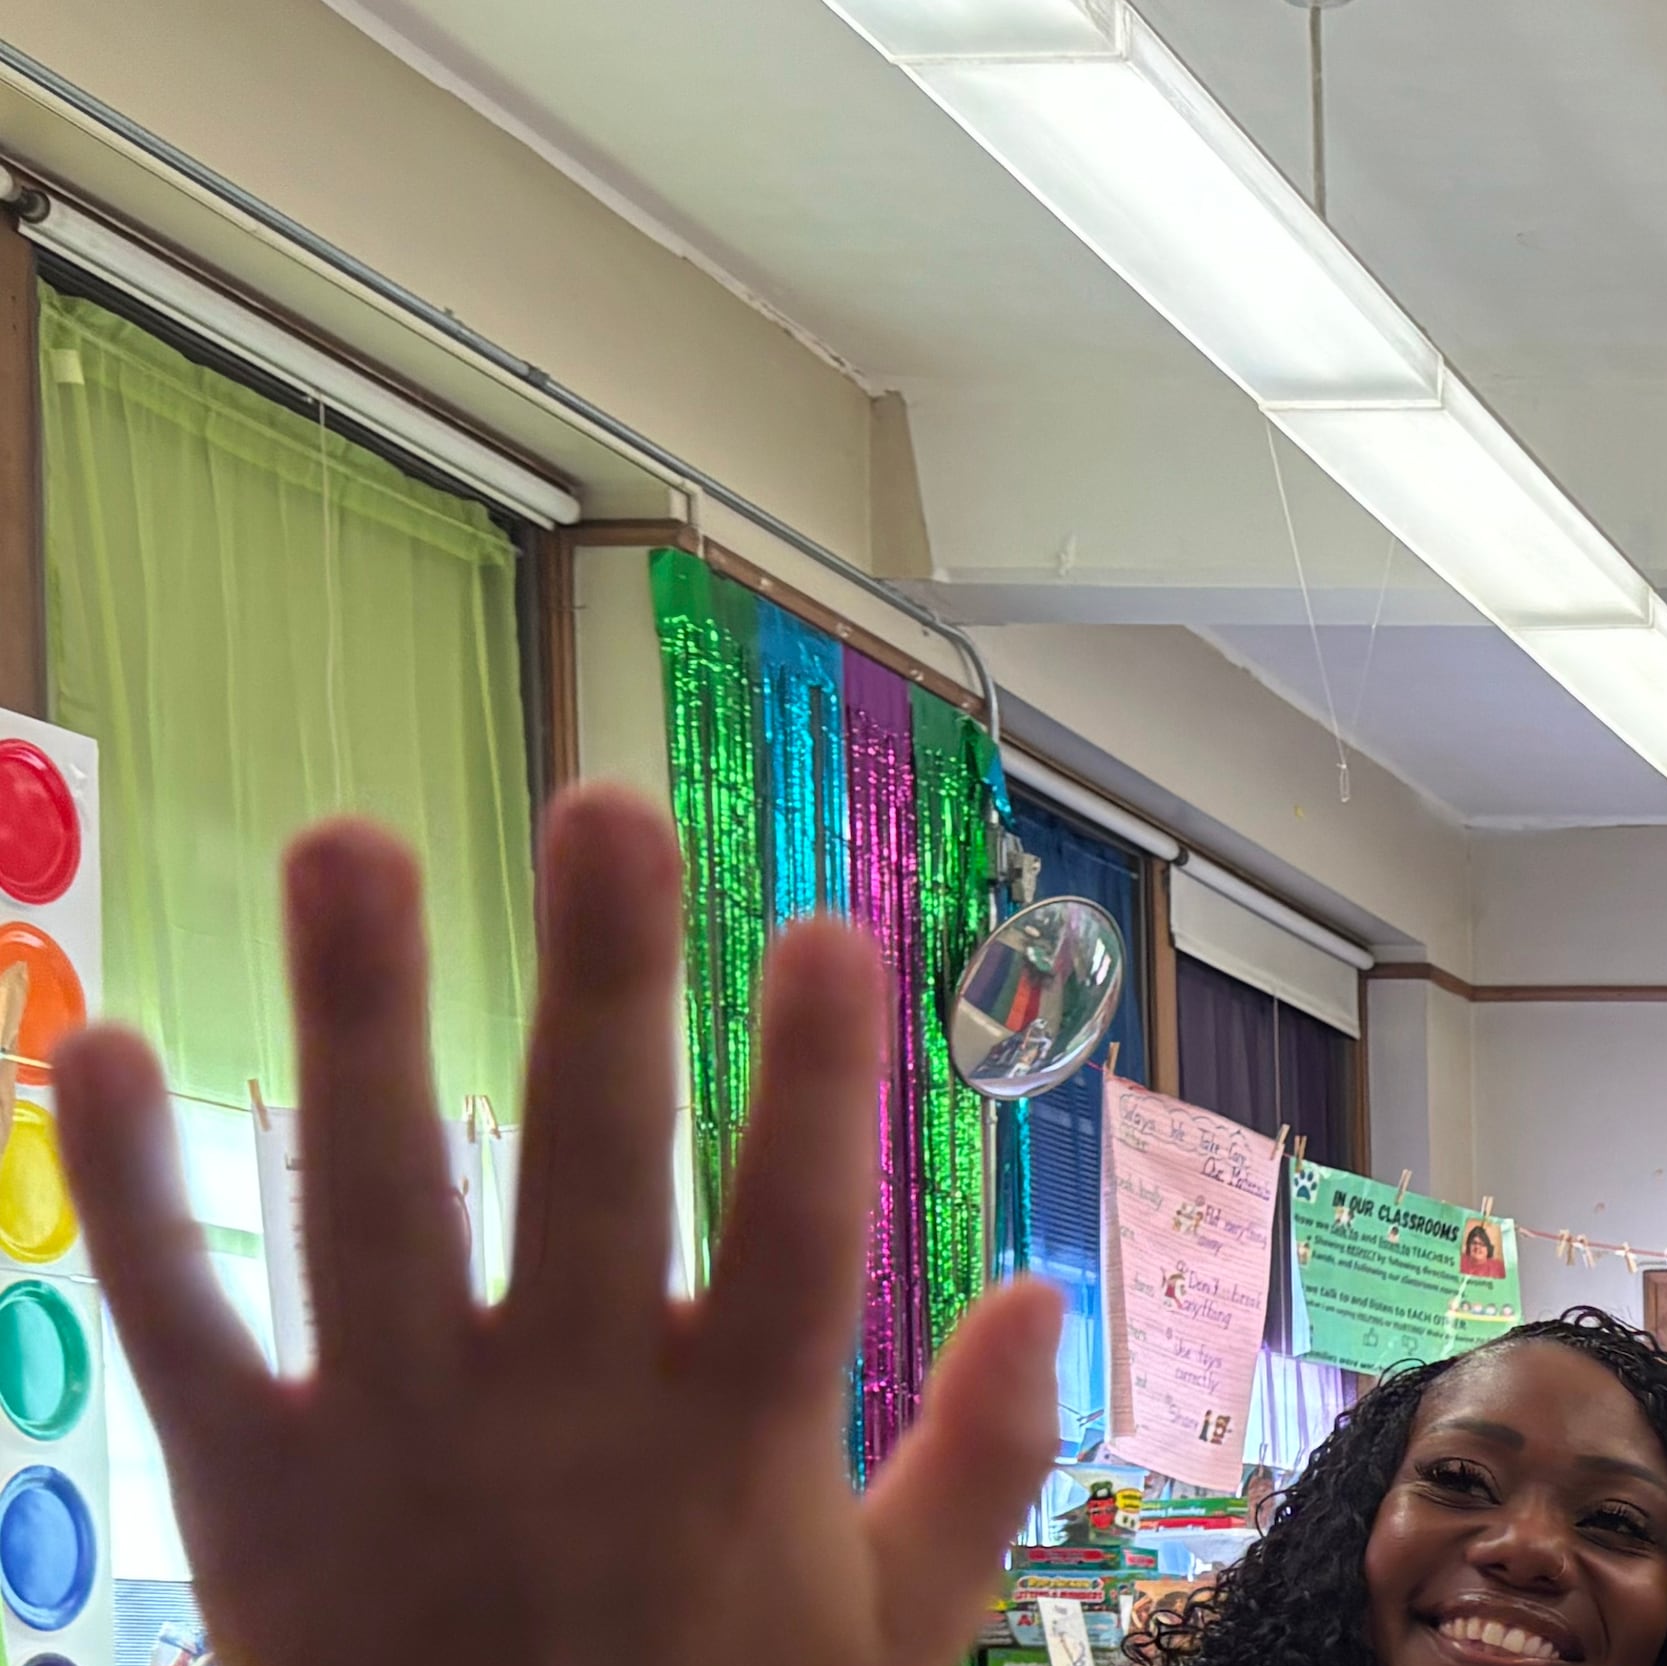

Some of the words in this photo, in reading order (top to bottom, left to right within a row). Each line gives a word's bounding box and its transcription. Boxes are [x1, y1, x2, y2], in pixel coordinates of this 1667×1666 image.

[1332, 1190, 1346, 1207] IN
[1349, 1196, 1375, 1217] OUR
[1377, 1204, 1460, 1242] CLASSROOMS
[1360, 1230, 1378, 1245] and
[1411, 1246, 1455, 1267] TEACHERS
[1407, 1307, 1433, 1326] EACH
[1433, 1314, 1467, 1331] OTER
